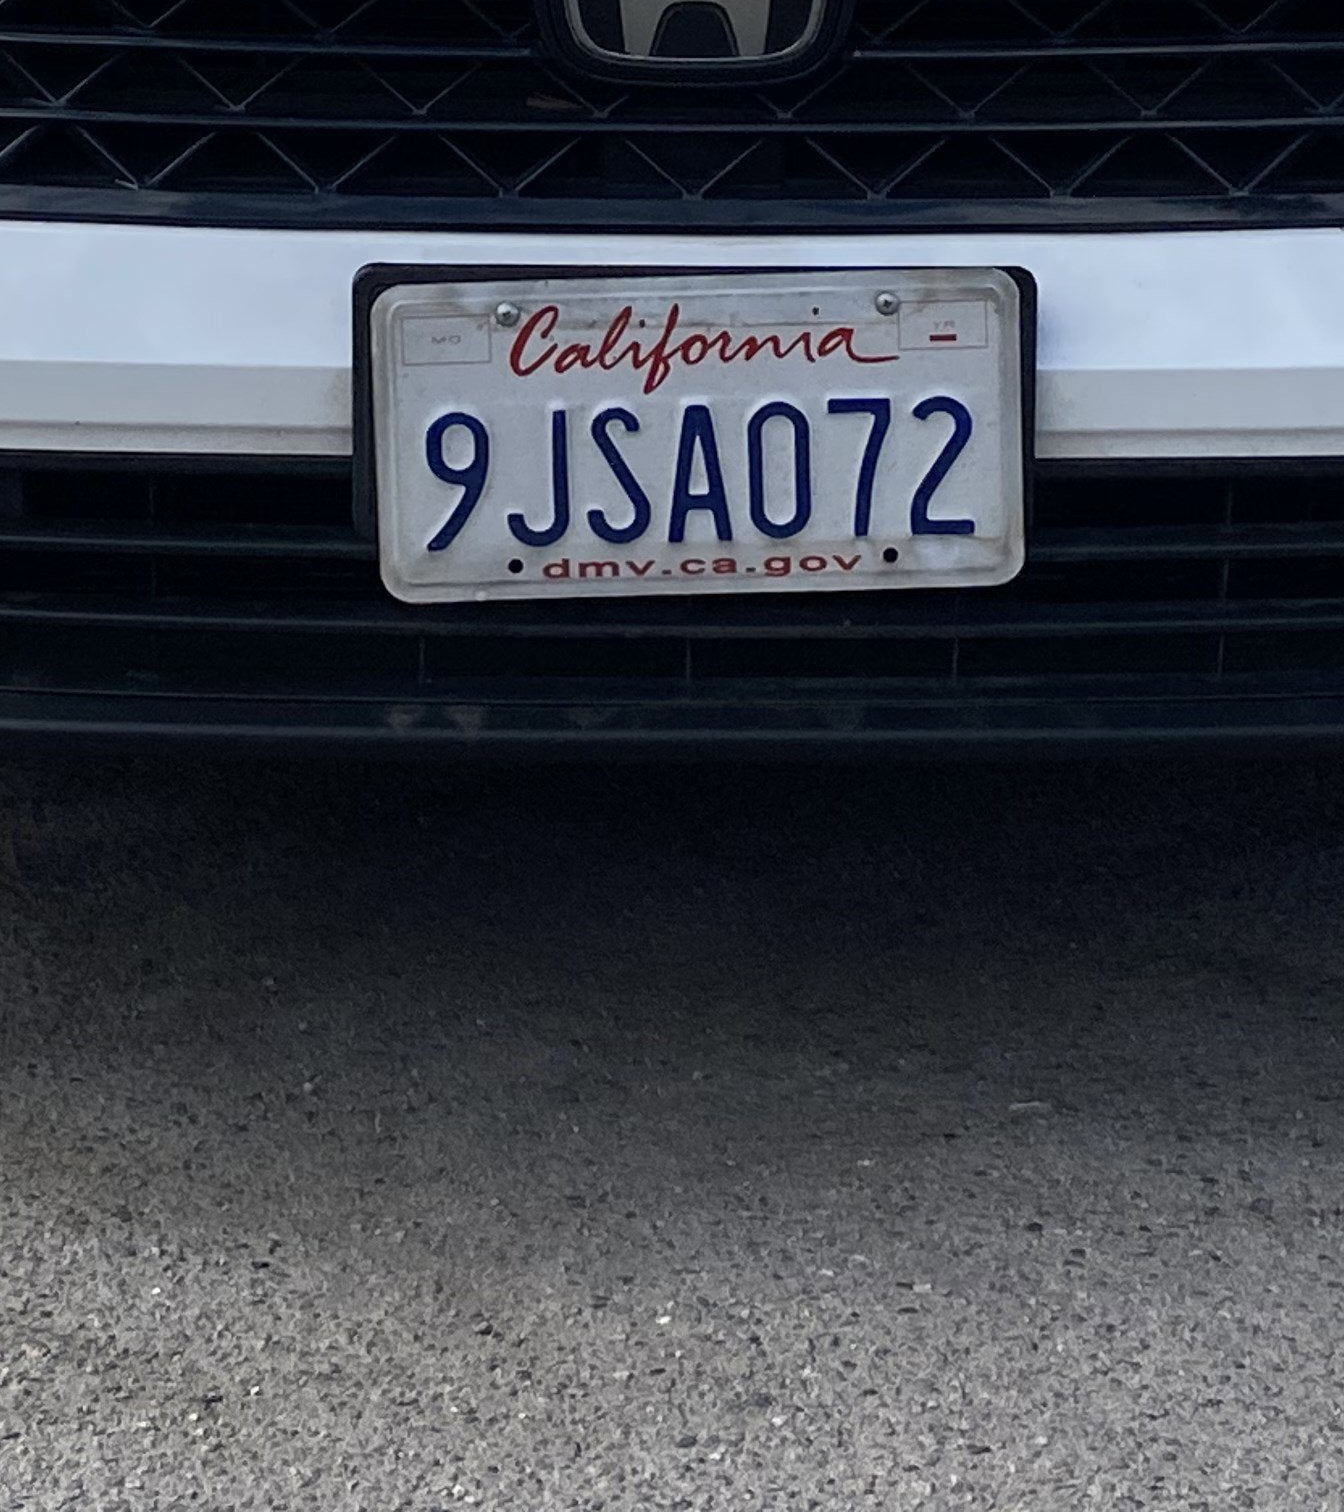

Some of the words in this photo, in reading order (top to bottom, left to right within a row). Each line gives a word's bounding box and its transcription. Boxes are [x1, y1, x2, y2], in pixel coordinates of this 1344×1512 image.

[508, 303, 899, 395] California
[425, 395, 975, 553] 9JSA072
[541, 553, 862, 580] dmv.ca.gov
